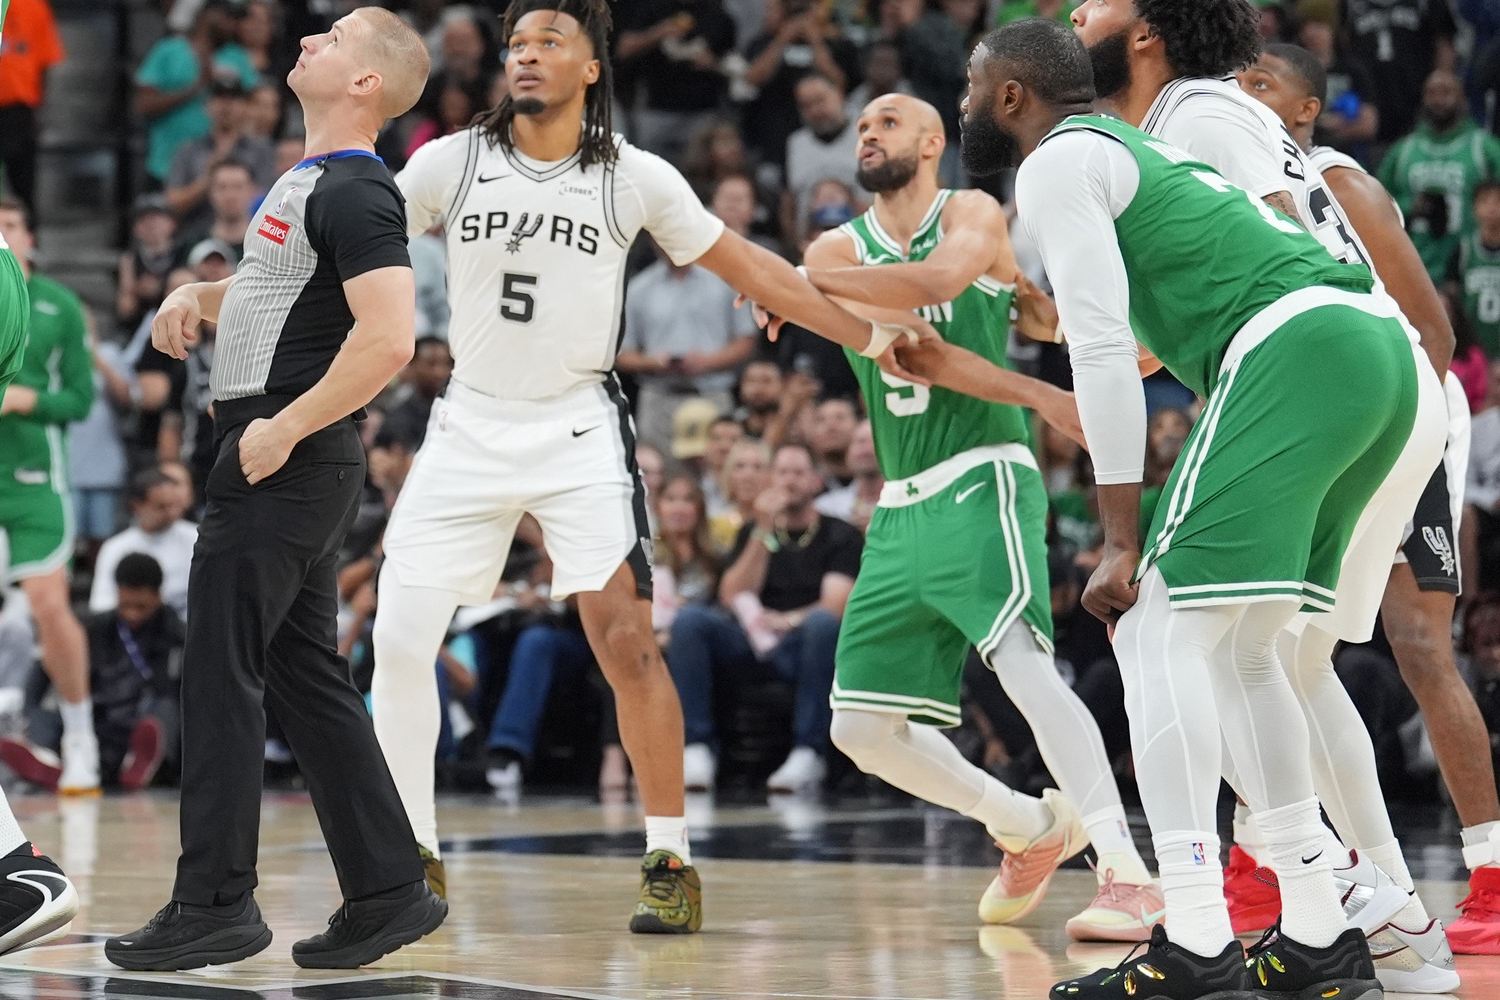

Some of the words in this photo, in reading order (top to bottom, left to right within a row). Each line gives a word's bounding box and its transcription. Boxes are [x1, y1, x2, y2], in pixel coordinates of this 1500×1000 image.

[563, 185, 594, 197] LEDGER
[260, 219, 287, 240] Emirates
[461, 211, 600, 256] SPURS
[499, 270, 542, 327] 5
